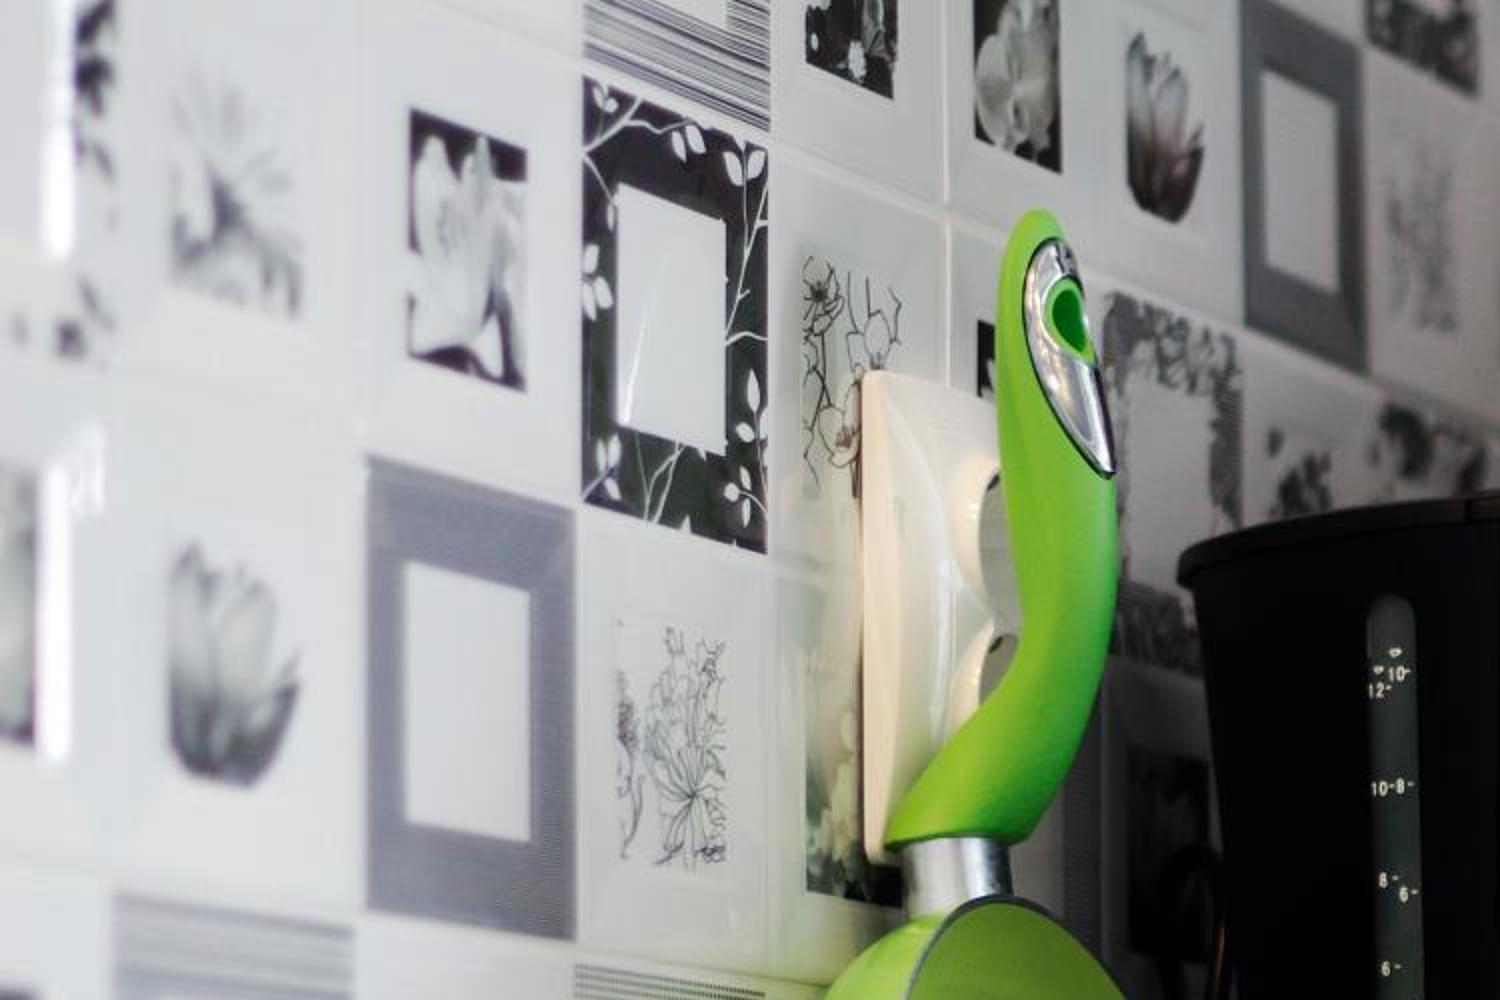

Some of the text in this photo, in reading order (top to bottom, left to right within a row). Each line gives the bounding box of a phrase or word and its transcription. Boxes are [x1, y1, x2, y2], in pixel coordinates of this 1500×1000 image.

[1369, 683, 1385, 699] 12
[1371, 778, 1405, 797] 10 8
[1379, 872, 1389, 889] 8
[1381, 961, 1391, 977] 6
